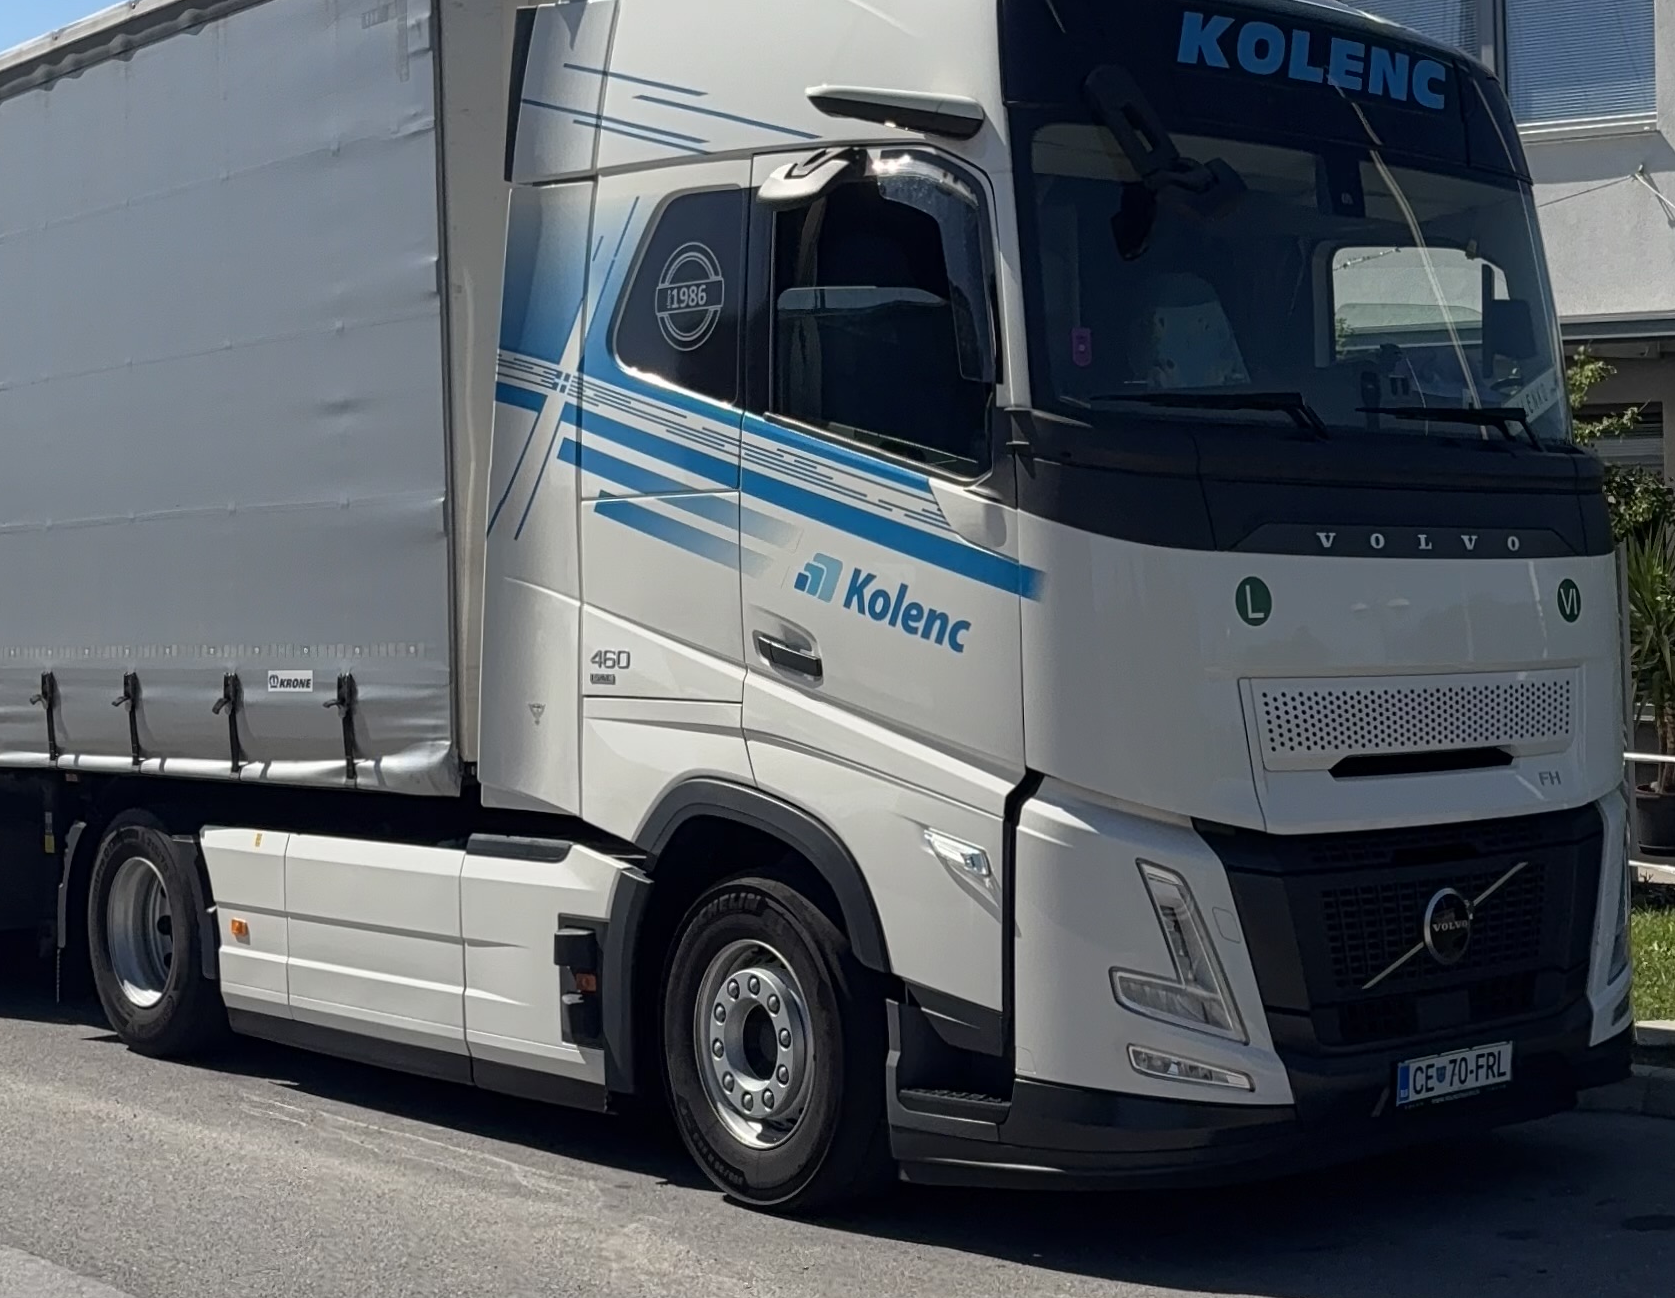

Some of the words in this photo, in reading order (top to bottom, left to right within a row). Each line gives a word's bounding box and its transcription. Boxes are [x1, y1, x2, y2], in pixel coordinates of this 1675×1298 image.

[1177, 11, 1446, 110] KOLENC
[671, 285, 707, 309] 1986
[1316, 531, 1520, 551] VOLVO
[842, 567, 972, 653] Kolenc
[1245, 584, 1265, 619] L
[590, 650, 631, 669] 460
[279, 678, 312, 689] KRONE
[1538, 770, 1562, 787] FH
[1432, 920, 1468, 932] VOLVO
[1412, 1063, 1435, 1095] CE
[1448, 1050, 1507, 1087] 70-FRL
